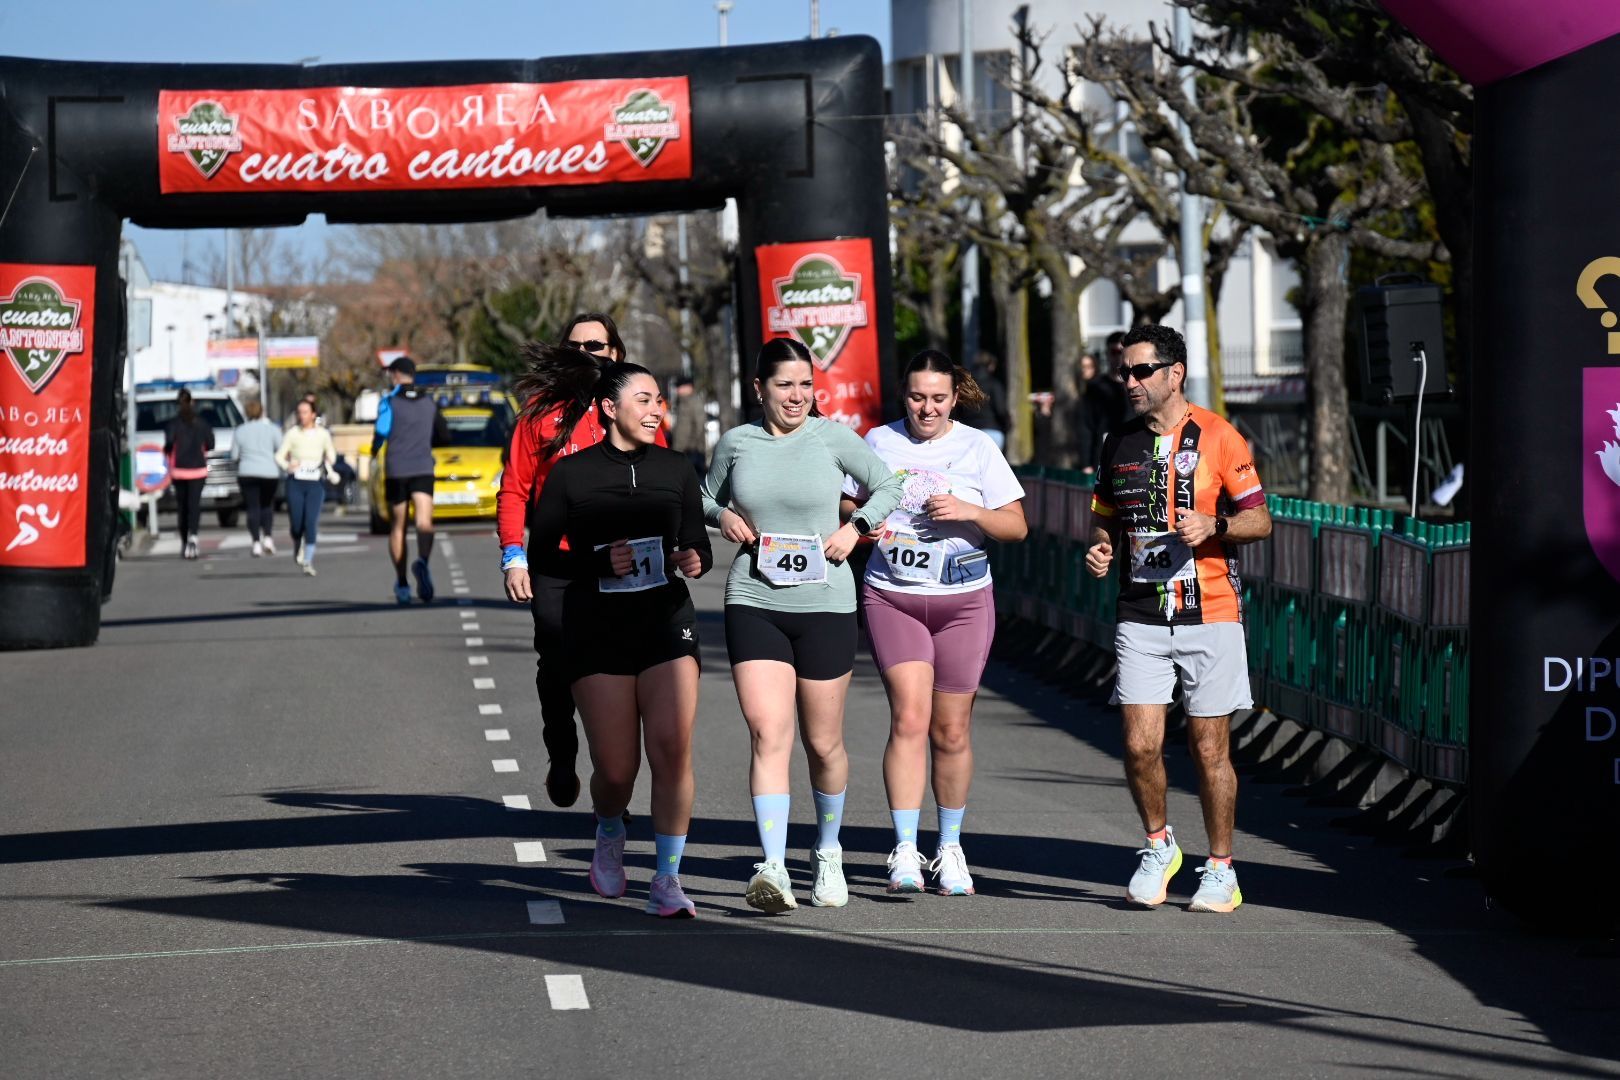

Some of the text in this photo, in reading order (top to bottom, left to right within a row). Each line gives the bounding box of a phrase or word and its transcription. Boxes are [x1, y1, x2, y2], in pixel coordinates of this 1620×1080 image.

[239, 137, 609, 183] cuatro cantones
[782, 284, 853, 305] cuatro
[2, 308, 72, 326] cuatro
[777, 553, 808, 572] 49
[888, 546, 930, 569] 102
[1144, 551, 1172, 569] 48
